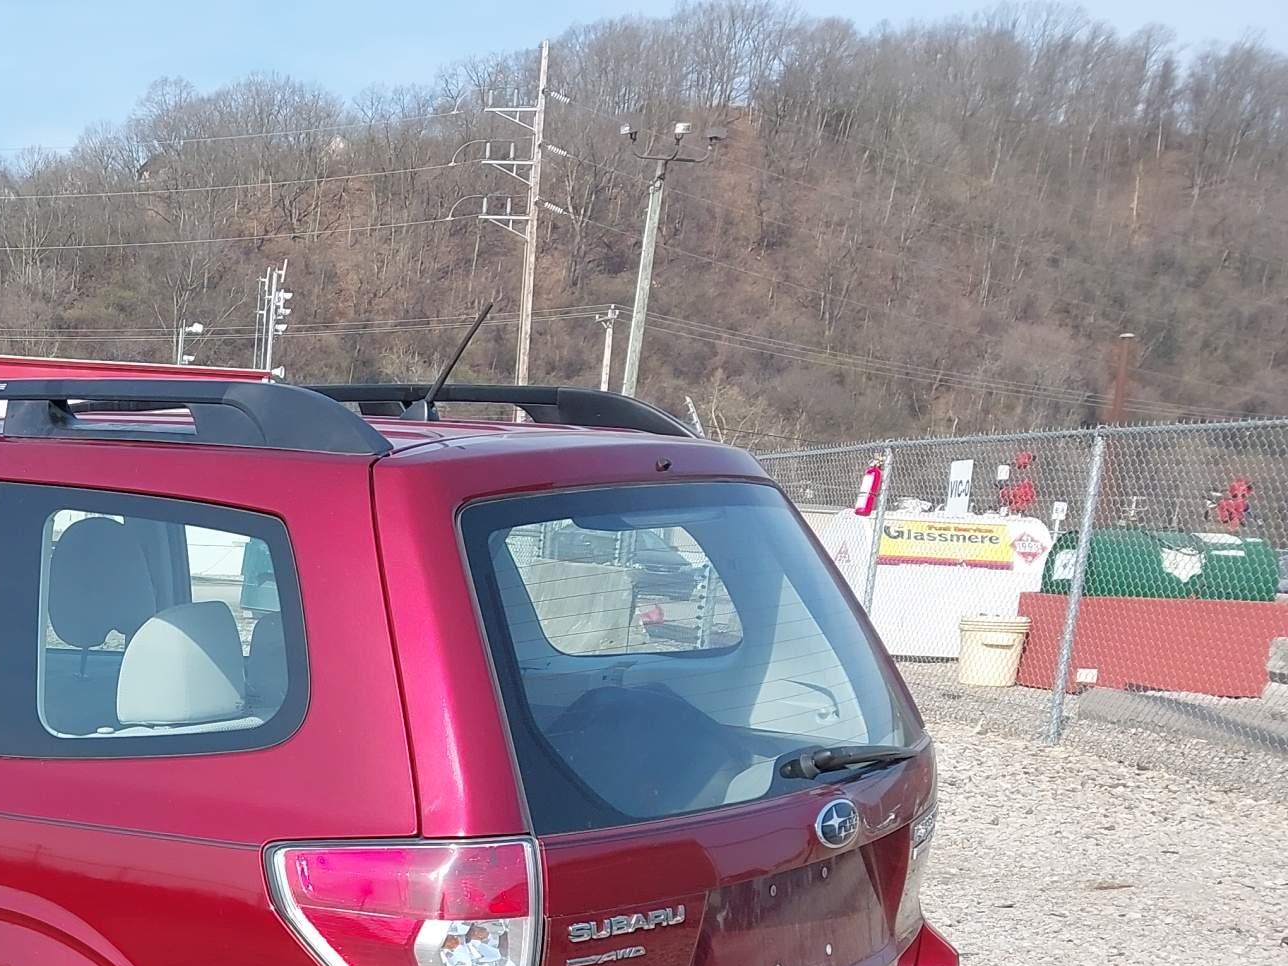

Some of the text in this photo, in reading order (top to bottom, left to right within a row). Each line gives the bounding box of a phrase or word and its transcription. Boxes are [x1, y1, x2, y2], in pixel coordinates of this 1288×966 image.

[883, 525, 1001, 545] Glassmere
[568, 904, 685, 943] SUBARU
[597, 946, 646, 965] AWD
